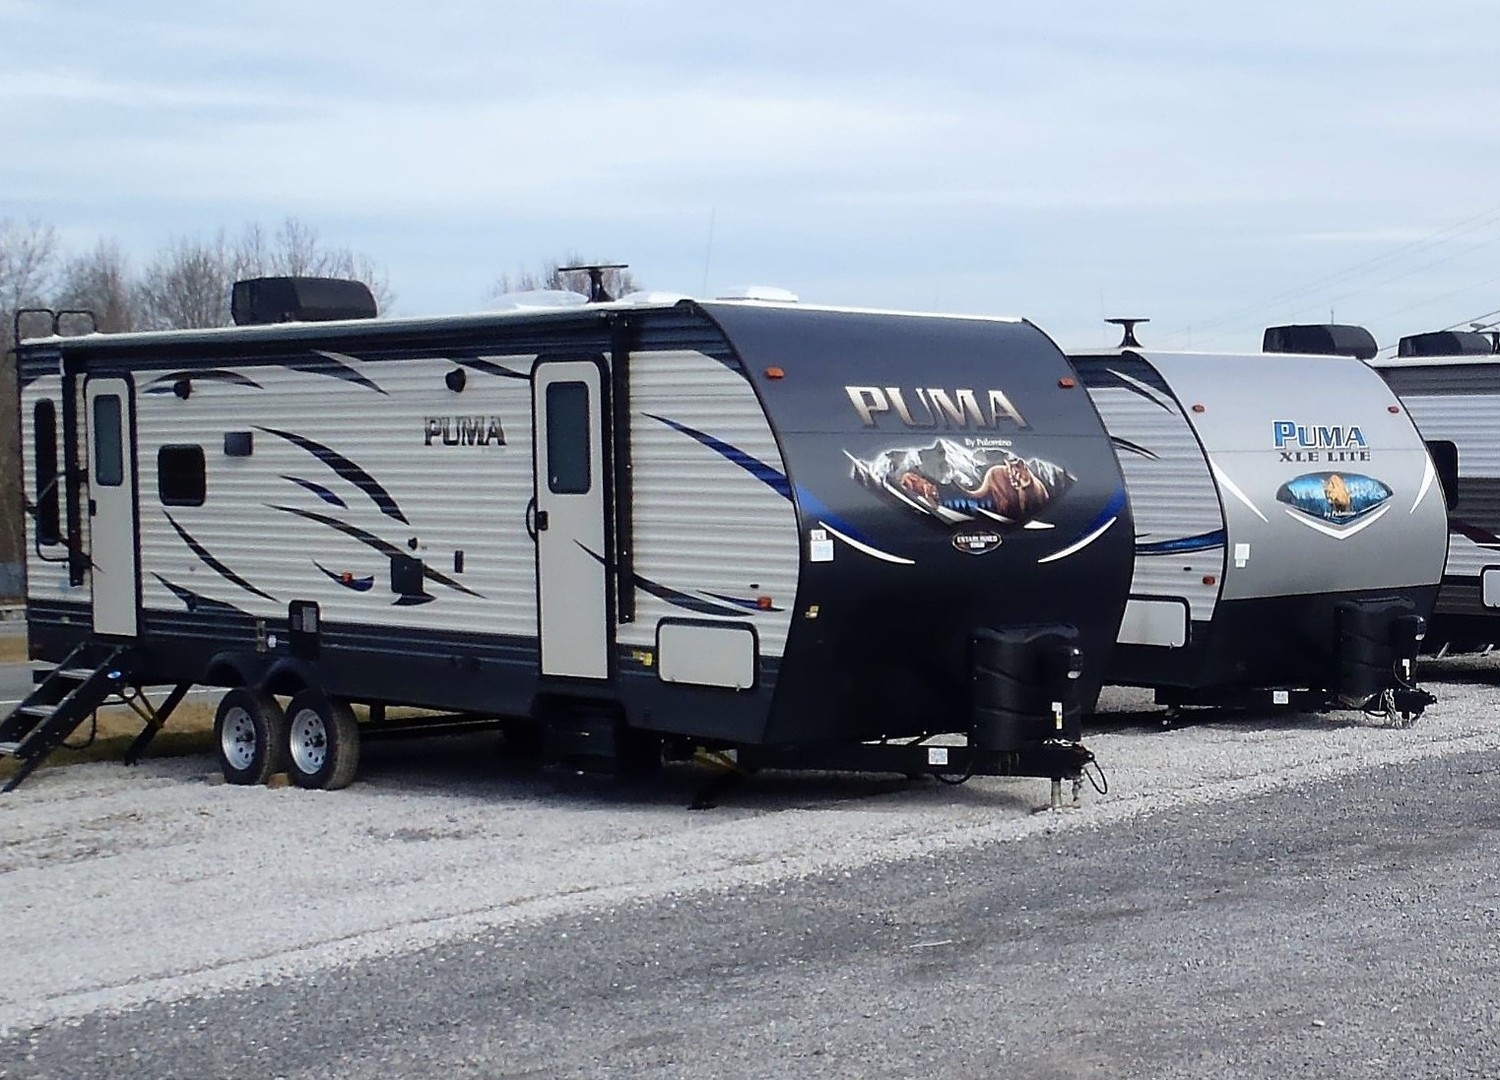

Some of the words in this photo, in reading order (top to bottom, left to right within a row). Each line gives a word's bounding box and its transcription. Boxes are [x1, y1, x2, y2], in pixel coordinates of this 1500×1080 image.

[844, 385, 1032, 431] PUMA
[424, 415, 508, 447] PUMA
[1273, 420, 1369, 450] PUMA
[1280, 451, 1319, 462] XLE
[1328, 451, 1371, 462] LITE
